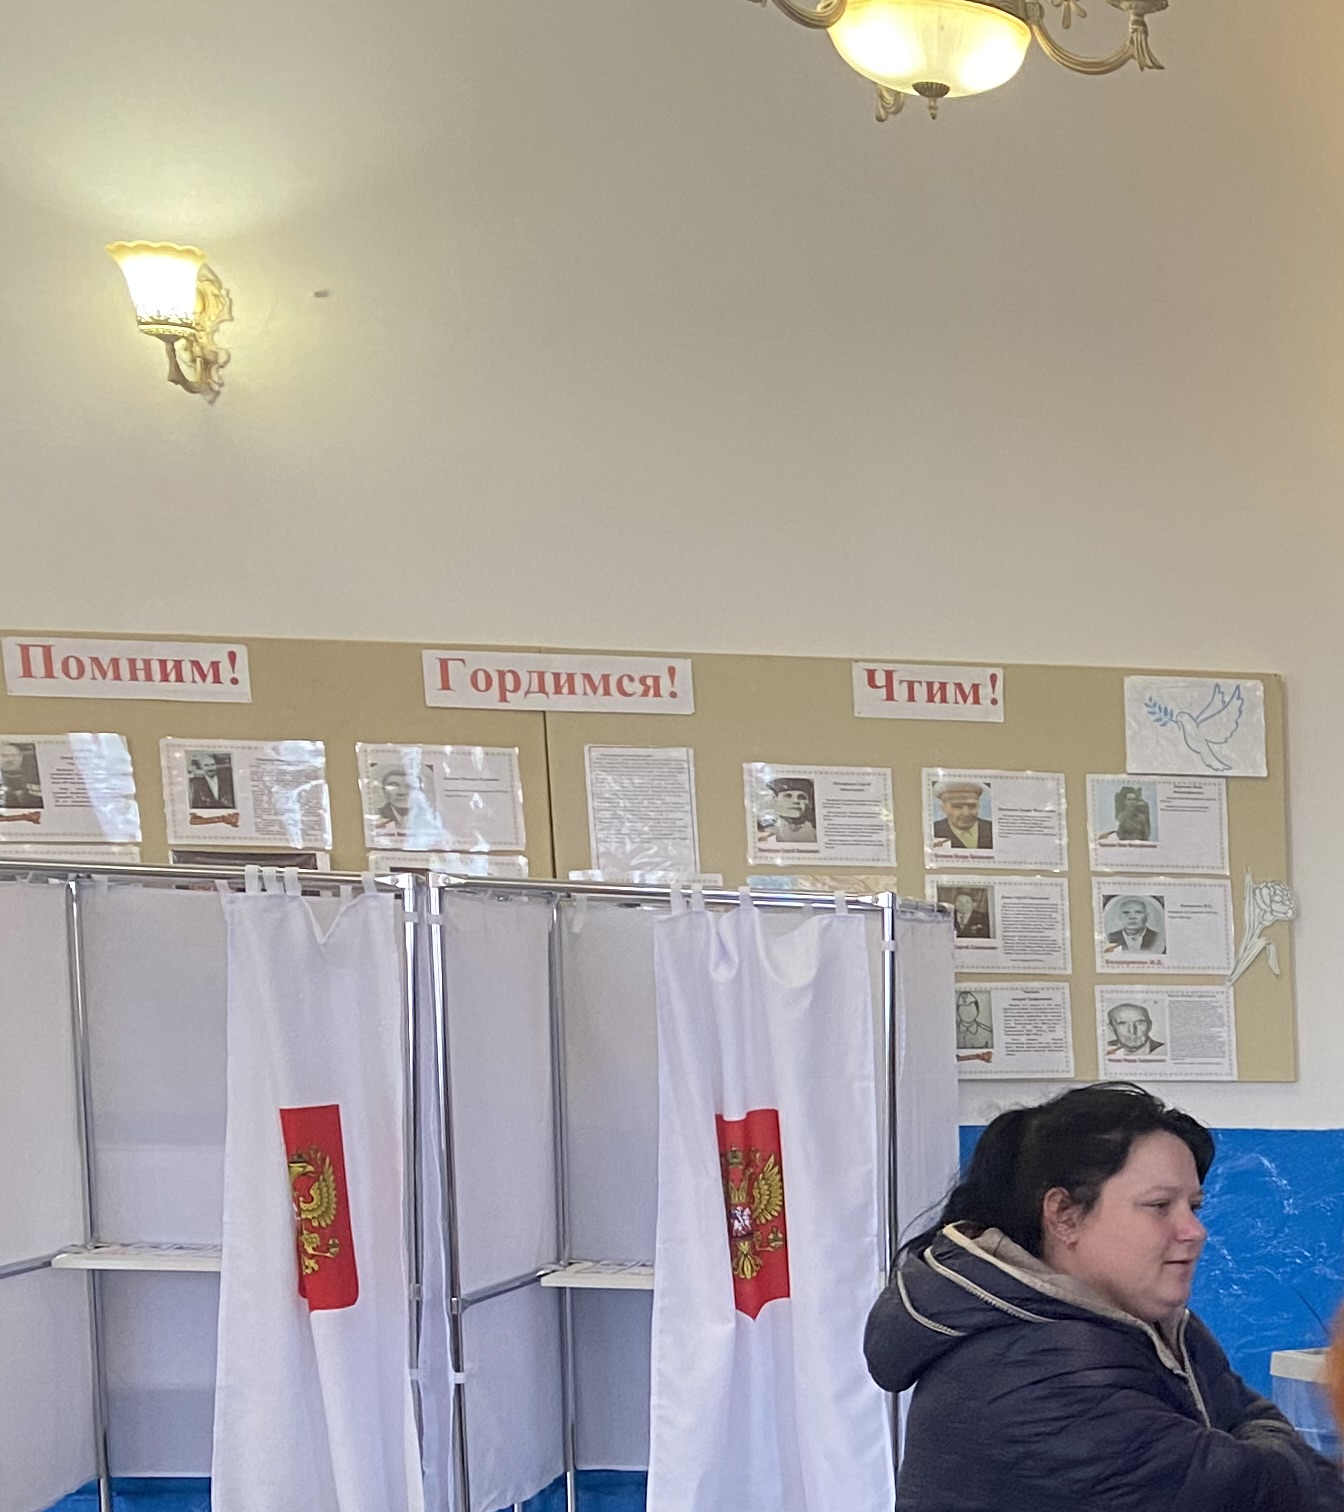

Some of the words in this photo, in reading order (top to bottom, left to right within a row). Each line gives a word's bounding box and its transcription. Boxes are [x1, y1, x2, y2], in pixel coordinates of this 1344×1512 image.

[17, 643, 241, 686] Помним!
[435, 656, 679, 703] Гордимся!
[863, 668, 1001, 707] Чтим!
